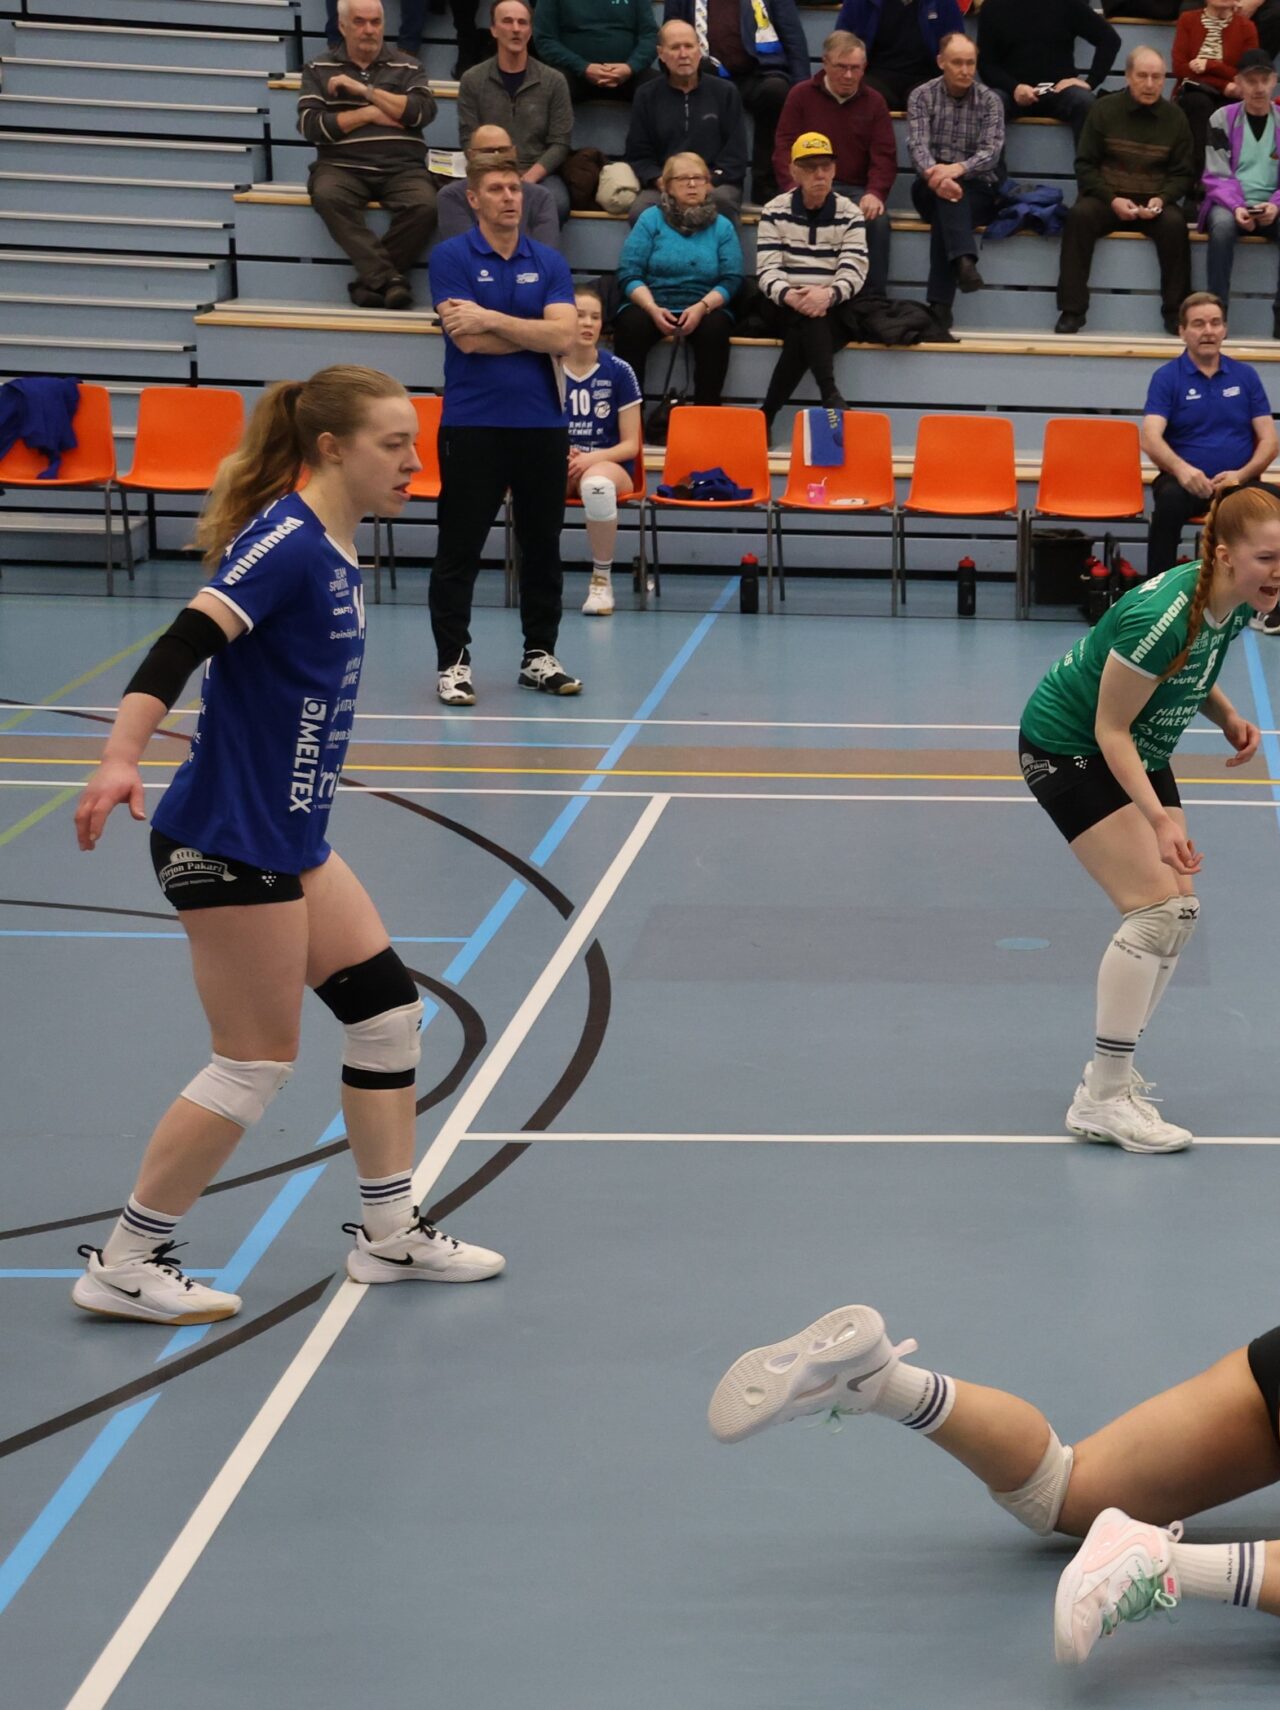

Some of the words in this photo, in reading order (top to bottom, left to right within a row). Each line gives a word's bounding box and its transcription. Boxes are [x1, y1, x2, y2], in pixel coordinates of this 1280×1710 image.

[569, 388, 591, 416] 10
[1130, 591, 1189, 664] minimani
[288, 721, 323, 814] MELTEX
